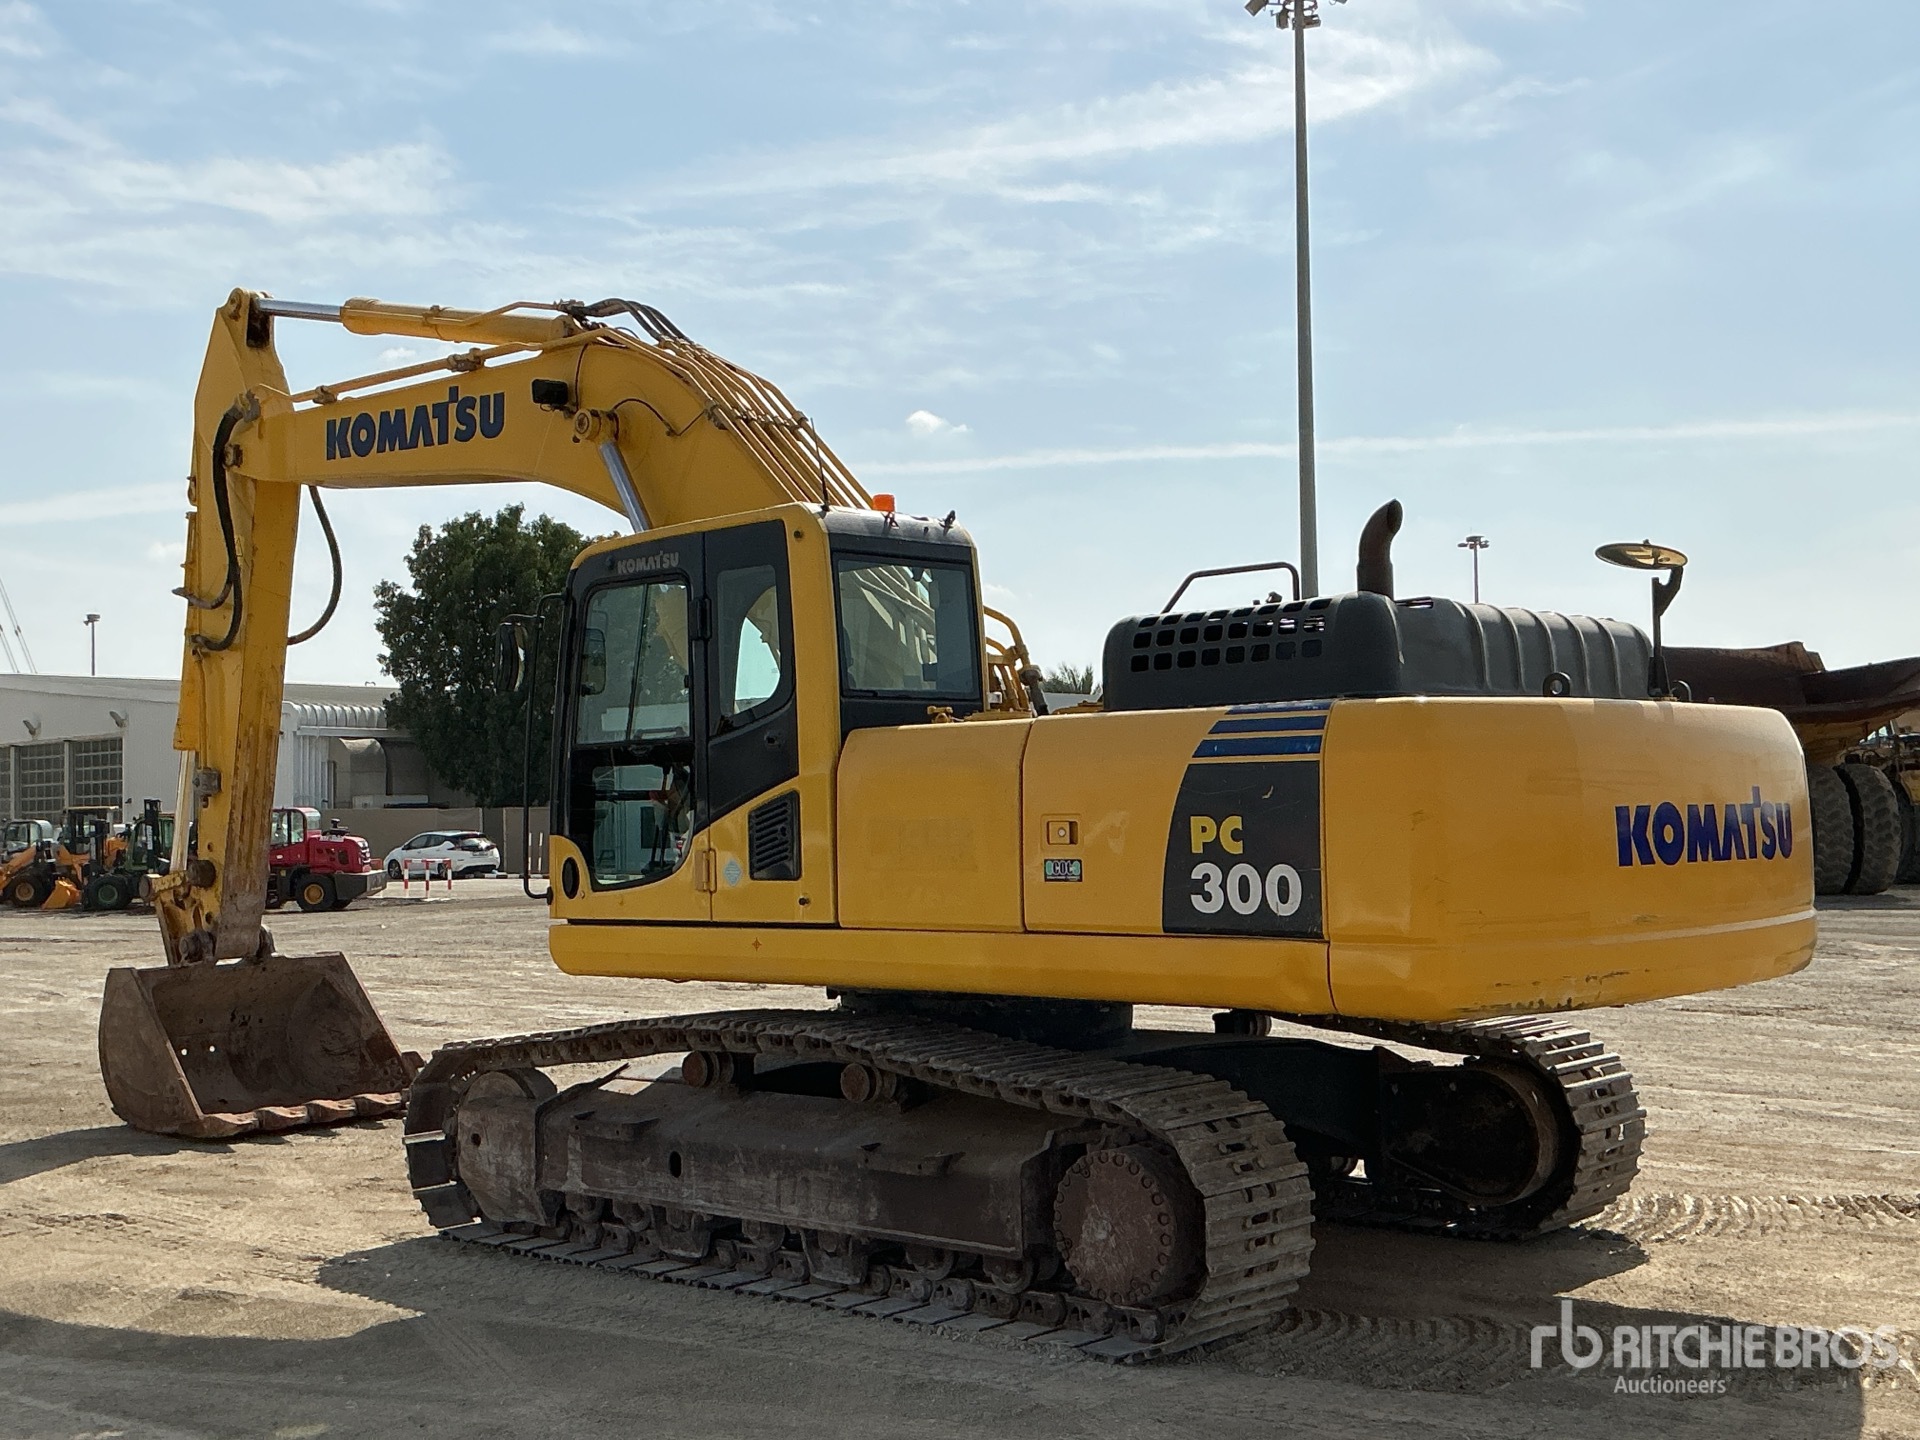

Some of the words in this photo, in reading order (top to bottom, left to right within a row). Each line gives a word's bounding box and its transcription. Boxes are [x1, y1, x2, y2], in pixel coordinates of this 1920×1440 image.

[326, 386, 505, 461] KOMATSU
[617, 550, 679, 575] KOMATSU
[1190, 815, 1244, 855] PC
[1615, 786, 1793, 867] KOMATSU
[1190, 862, 1303, 917] 300
